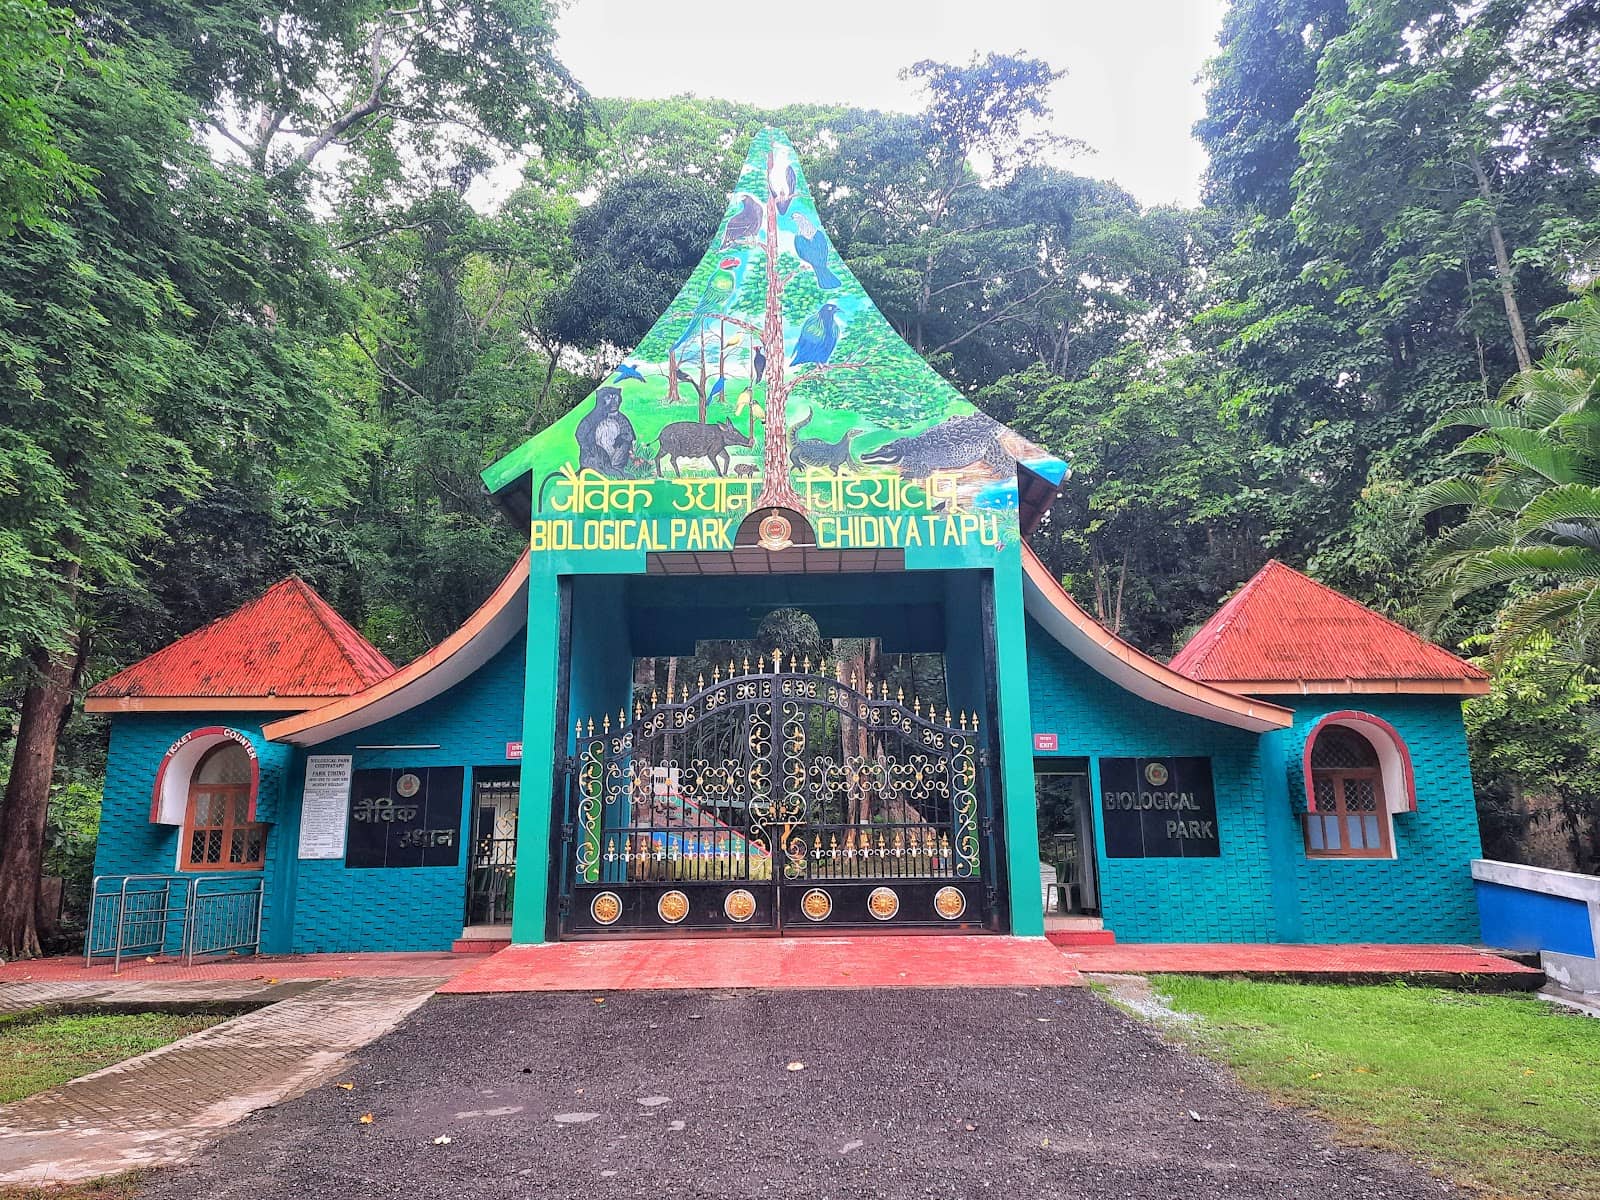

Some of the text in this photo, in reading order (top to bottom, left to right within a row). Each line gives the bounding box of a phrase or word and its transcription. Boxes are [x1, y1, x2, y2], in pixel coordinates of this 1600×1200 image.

[550, 462, 655, 513] जैविक
[530, 515, 999, 551] BIOLOGICAL PARK CHIDIYATAPU
[166, 729, 257, 760] TICKET COUNTER
[352, 798, 419, 824] जैविक
[1104, 791, 1201, 811] BIOLOGICAL
[1166, 820, 1216, 839] PARK
